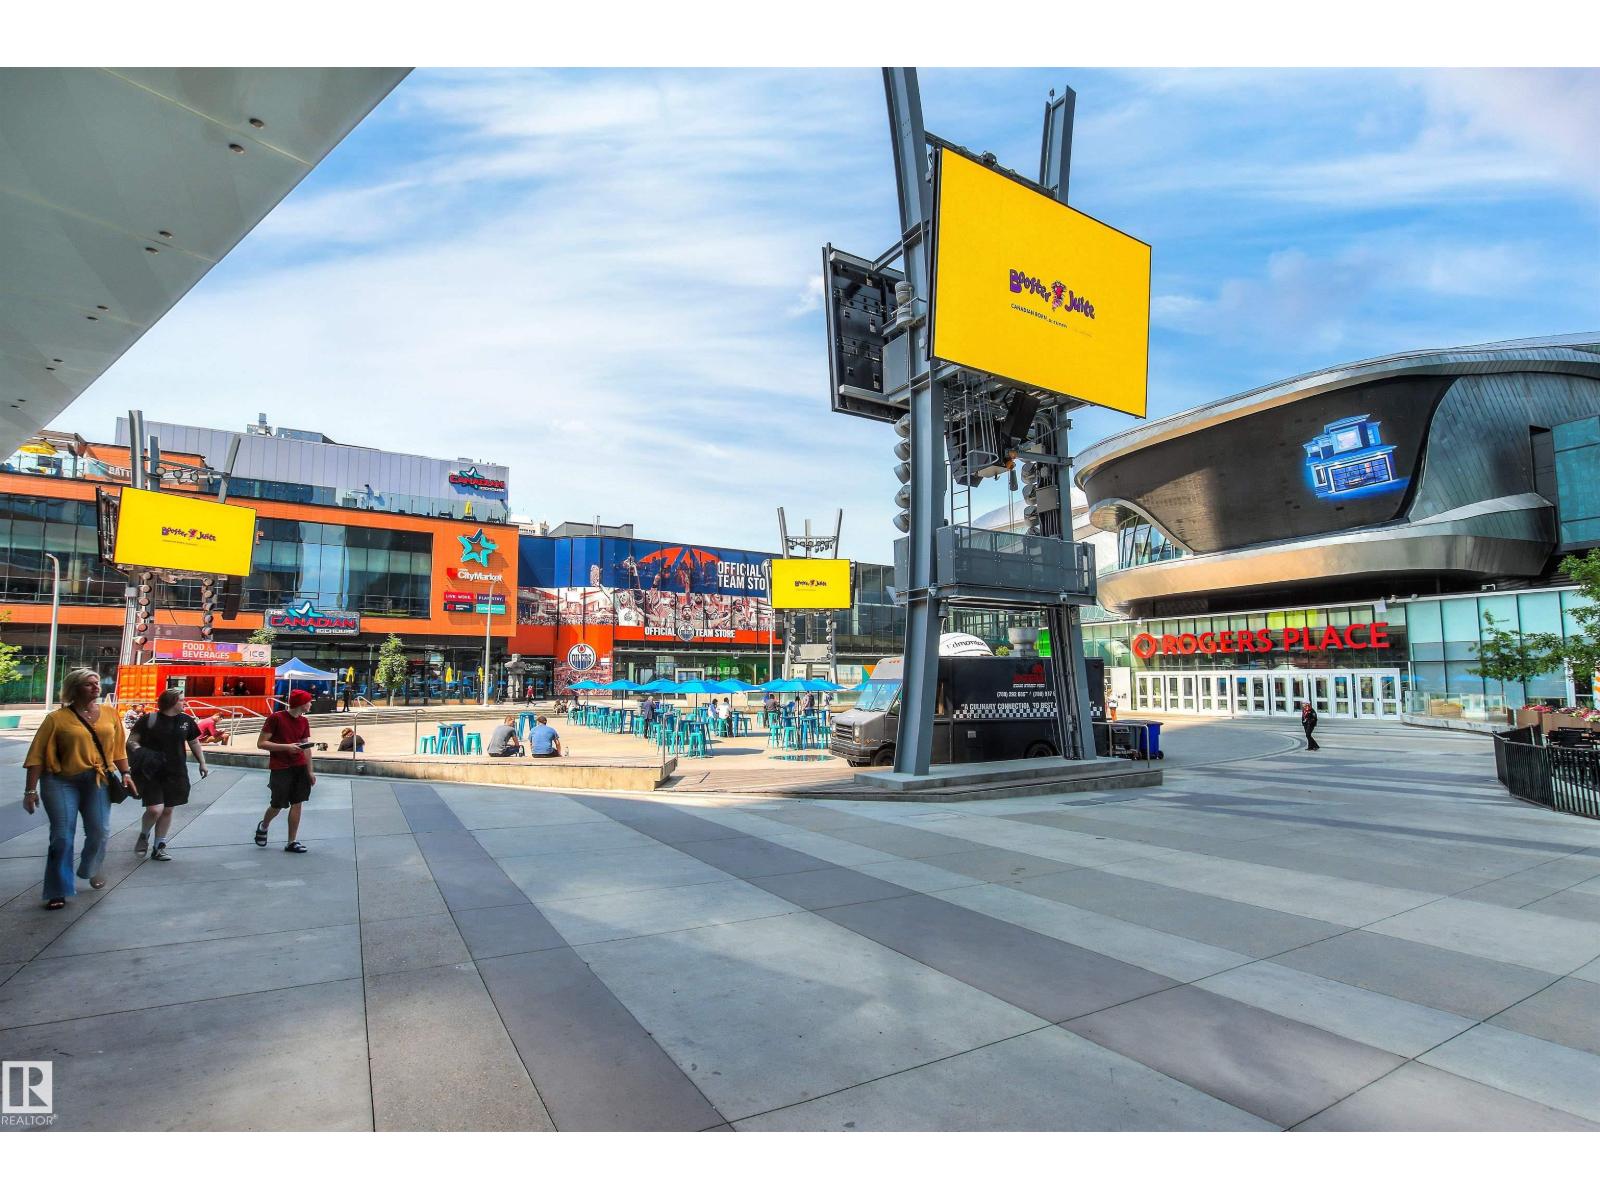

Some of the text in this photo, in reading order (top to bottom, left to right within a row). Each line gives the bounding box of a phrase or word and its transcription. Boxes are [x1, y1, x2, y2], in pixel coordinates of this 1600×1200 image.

[1009, 268, 1095, 319] Booster Juice
[718, 561, 762, 578] OFFICIAL
[457, 571, 502, 582] CityMarket
[718, 574, 745, 589] TEAM
[271, 616, 356, 629] CANADIAN
[645, 626, 676, 636] OFFICIAL
[696, 628, 713, 637] TEAM
[715, 630, 735, 638] STORE
[1162, 621, 1391, 655] ROGERS PLACE
[182, 642, 205, 650] FOOD
[182, 650, 230, 659] BEVERAGES
[571, 653, 592, 669] OILERS
[1040, 701, 1054, 709] BEST
